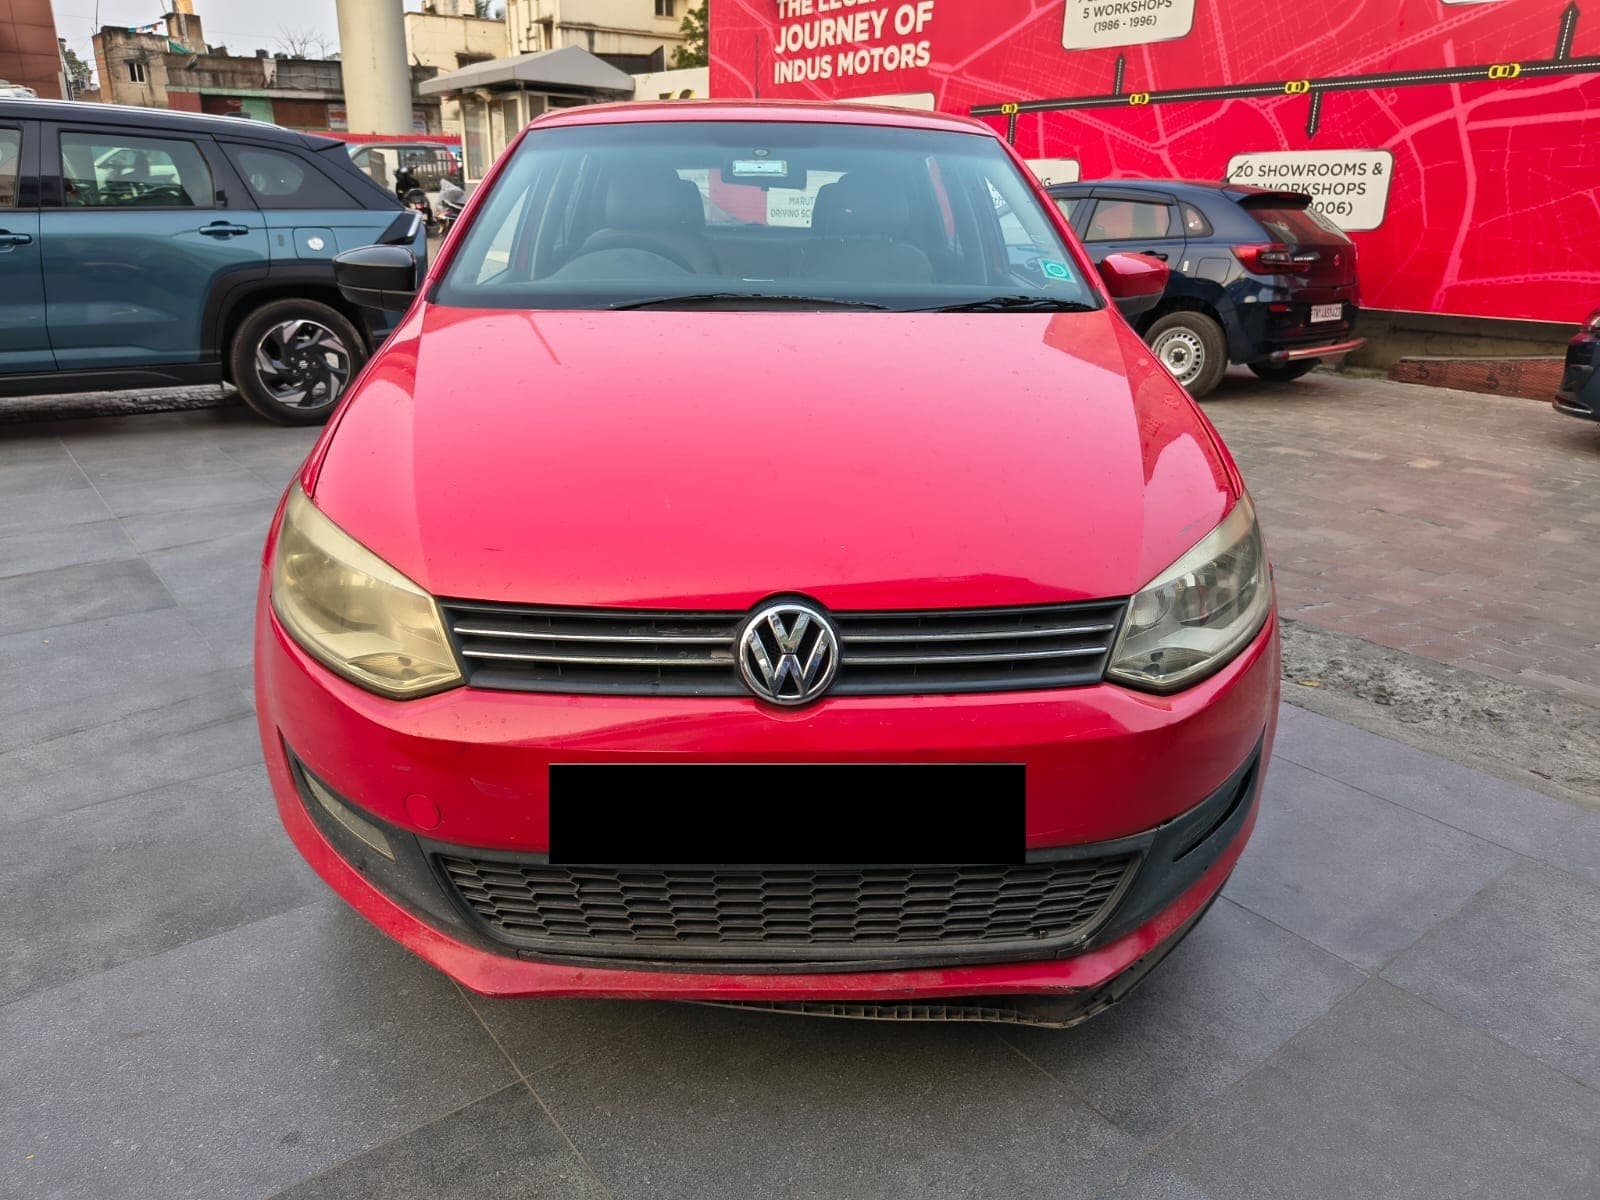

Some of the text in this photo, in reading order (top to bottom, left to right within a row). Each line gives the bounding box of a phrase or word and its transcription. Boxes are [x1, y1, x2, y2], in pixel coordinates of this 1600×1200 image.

[777, 0, 815, 19] THE
[1083, 0, 1173, 19] 5 WORKSHOPS
[775, 1, 934, 54] JOURNEY OF
[774, 41, 930, 84] INDUS MOTORS
[1235, 162, 1383, 178] 20 SHOWROOMS &
[770, 208, 799, 218] DRIVING
